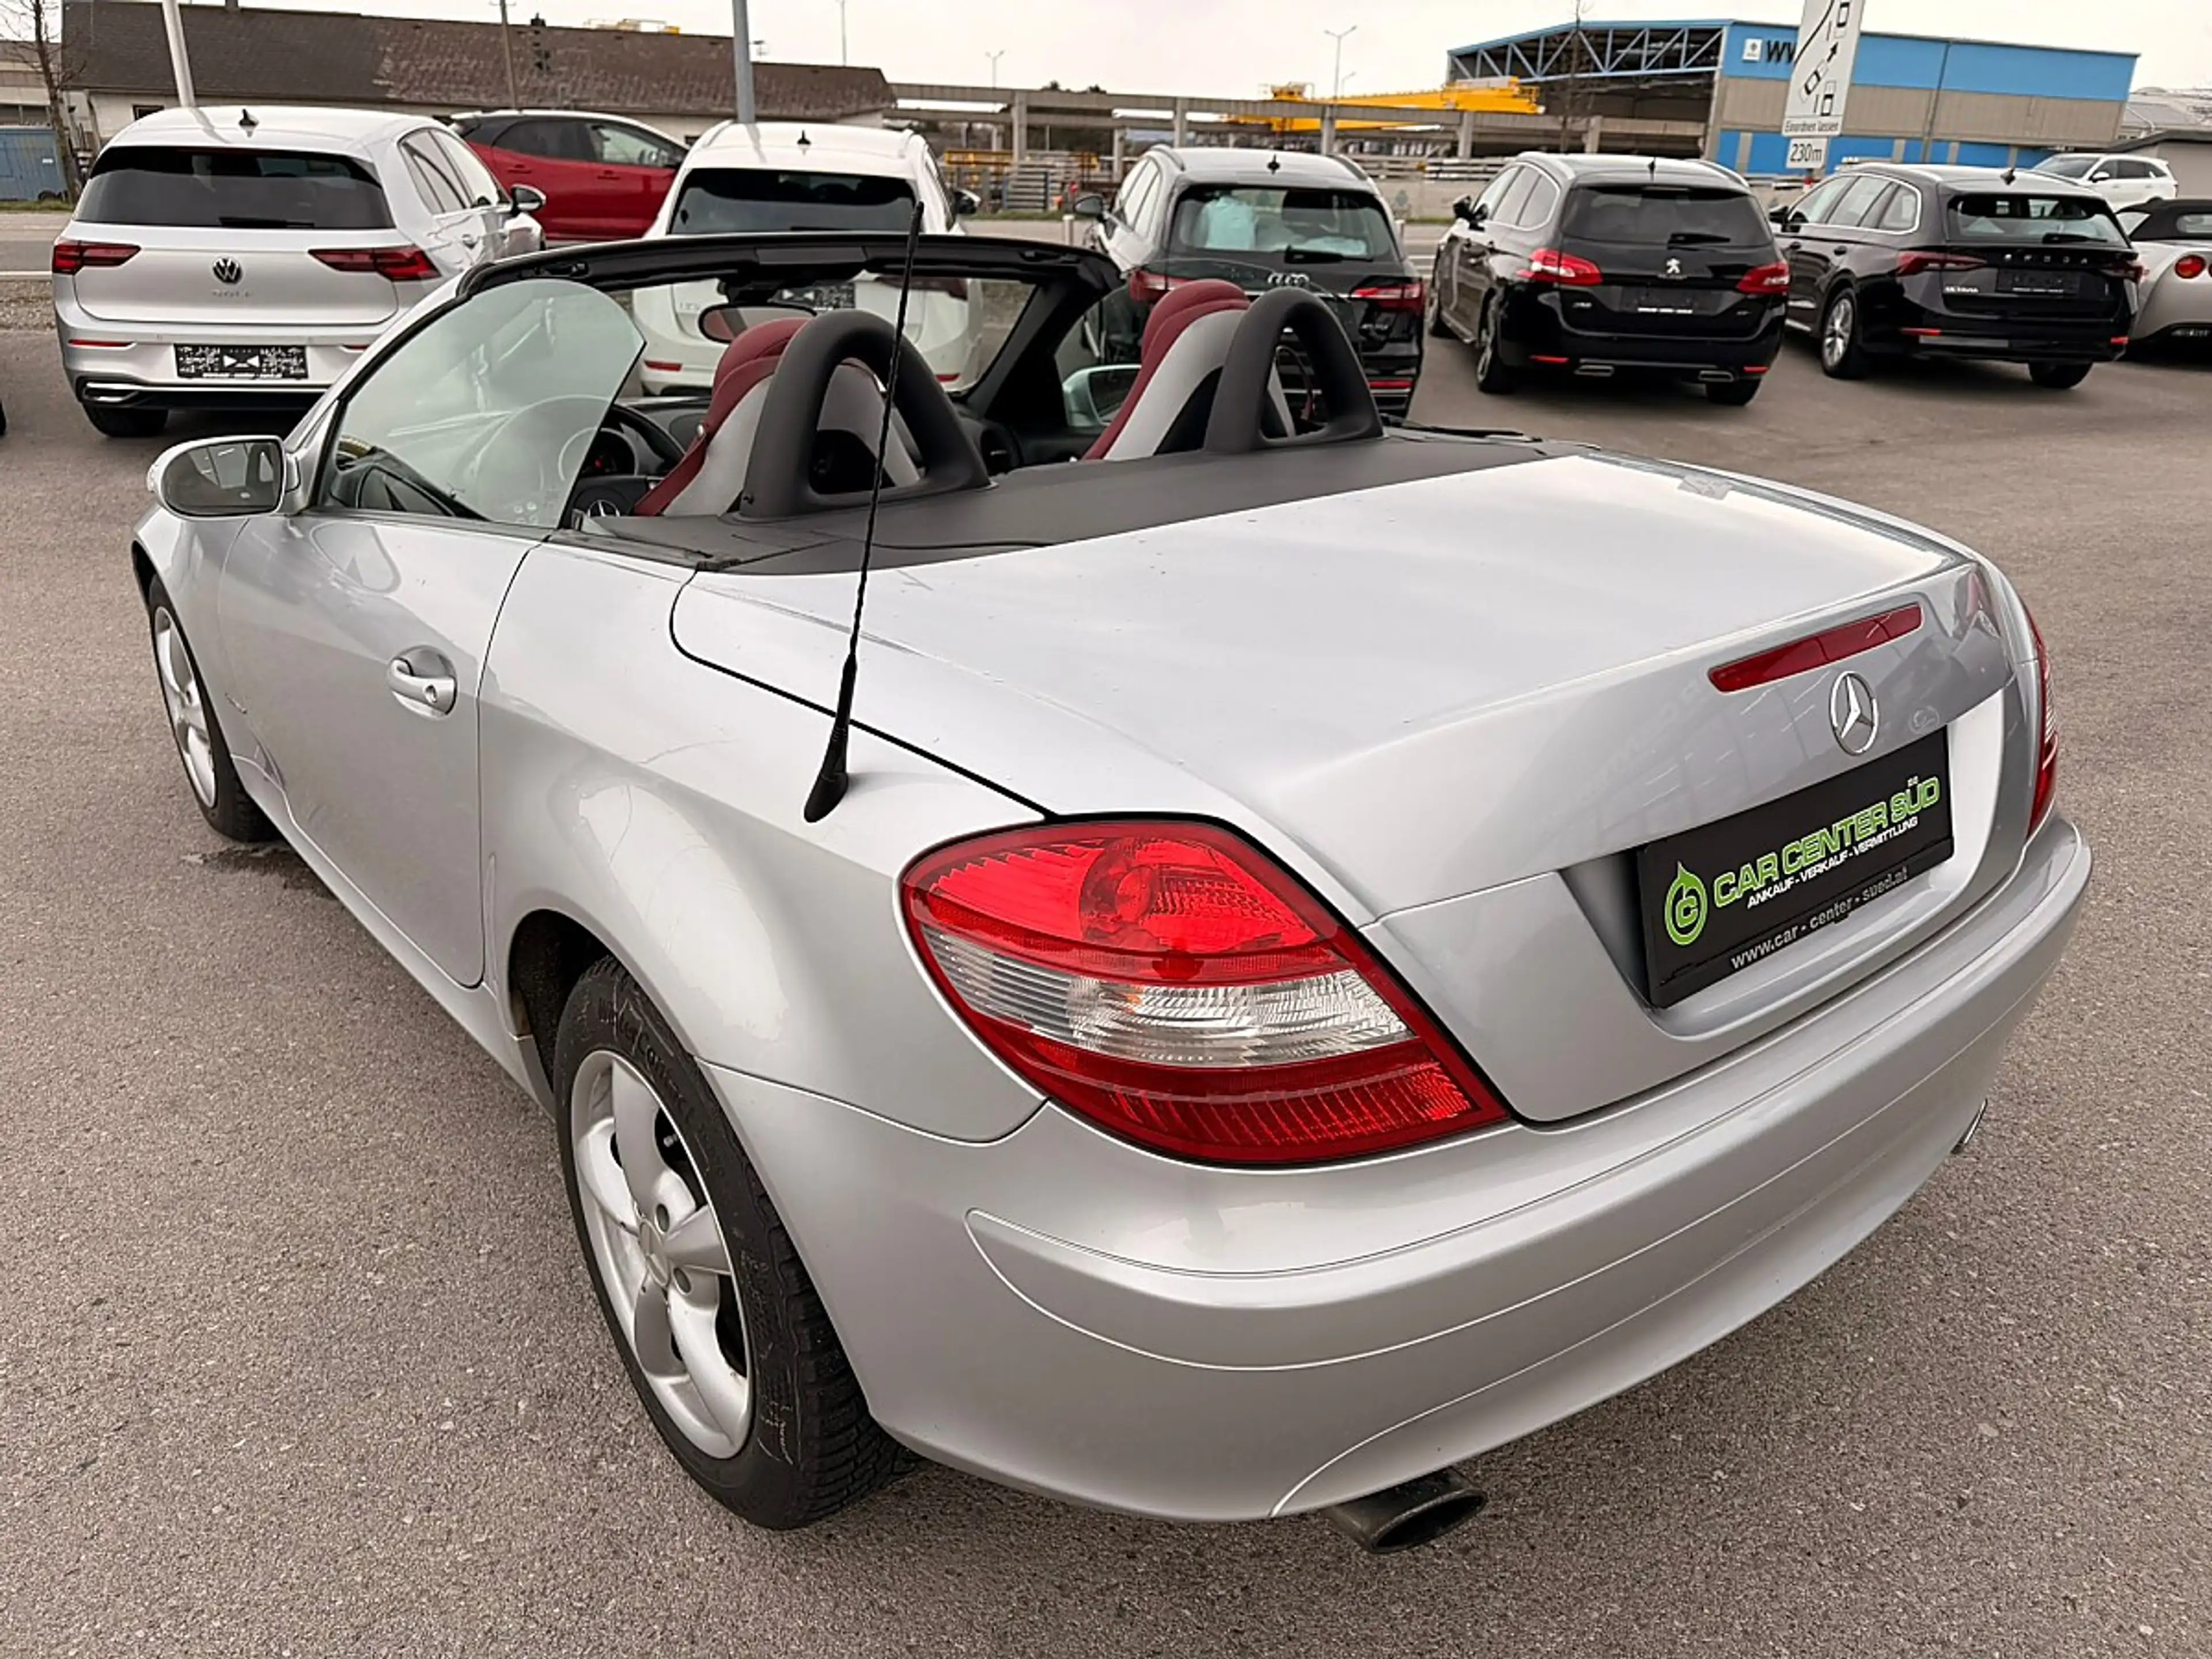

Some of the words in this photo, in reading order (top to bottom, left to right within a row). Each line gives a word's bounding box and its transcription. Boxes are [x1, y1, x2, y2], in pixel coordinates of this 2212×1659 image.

[1790, 143, 1822, 162] 230m
[1714, 851, 1779, 908] CAR
[1782, 801, 1888, 874] CENTER
[1890, 776, 1940, 823] SÜD
